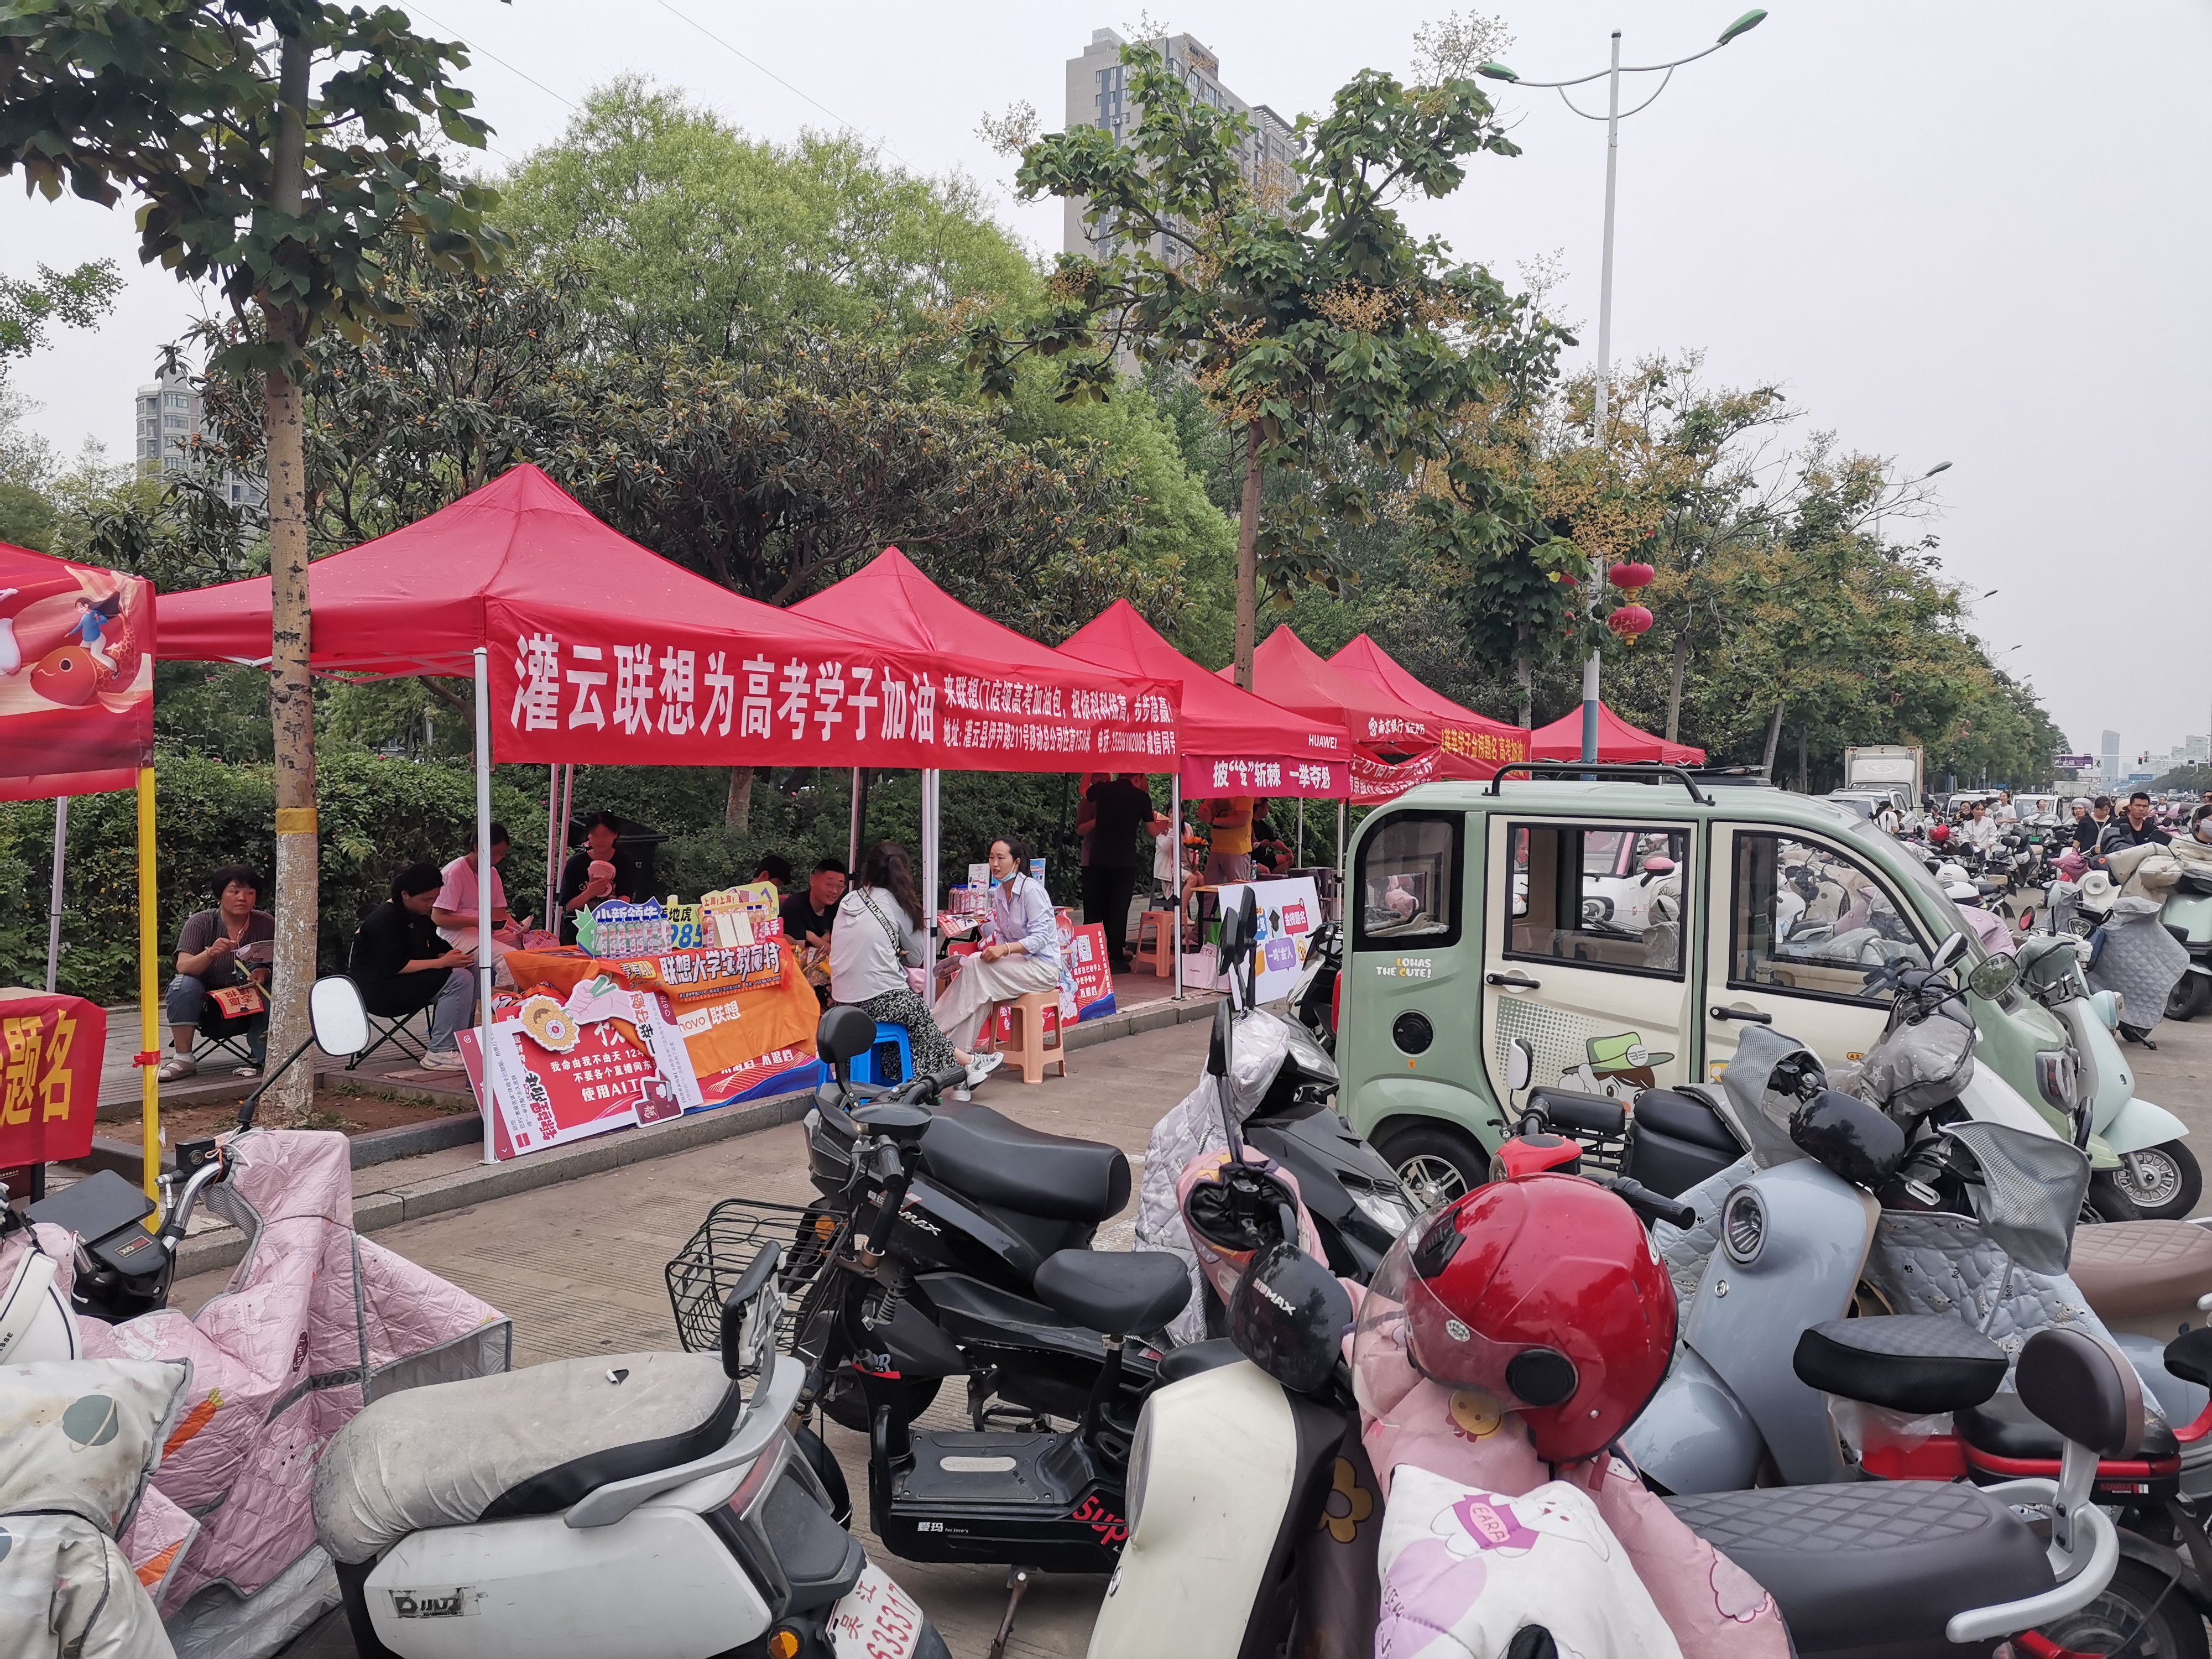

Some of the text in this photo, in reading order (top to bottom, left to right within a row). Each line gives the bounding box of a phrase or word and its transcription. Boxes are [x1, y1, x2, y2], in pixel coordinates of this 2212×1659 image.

[509, 632, 935, 744] 灌云联想为高考学子加油
[1379, 718, 1404, 734] 南京银行
[1308, 733, 1337, 749] HUAWEI
[1288, 763, 1331, 790] 一举夺魁
[1376, 966, 1431, 979] THE CUTE!
[1396, 957, 1432, 968] LOHAS
[709, 1000, 742, 1025] 联想
[0, 1008, 77, 1127] 题名
[550, 1050, 622, 1072] 我命由我不由天
[573, 1059, 656, 1084] 不要各个直播间东
[898, 1208, 942, 1237] MAX
[293, 1339, 306, 1368] Lucky
[917, 1521, 943, 1532] 爱玛
[834, 1580, 877, 1640] 吴江
